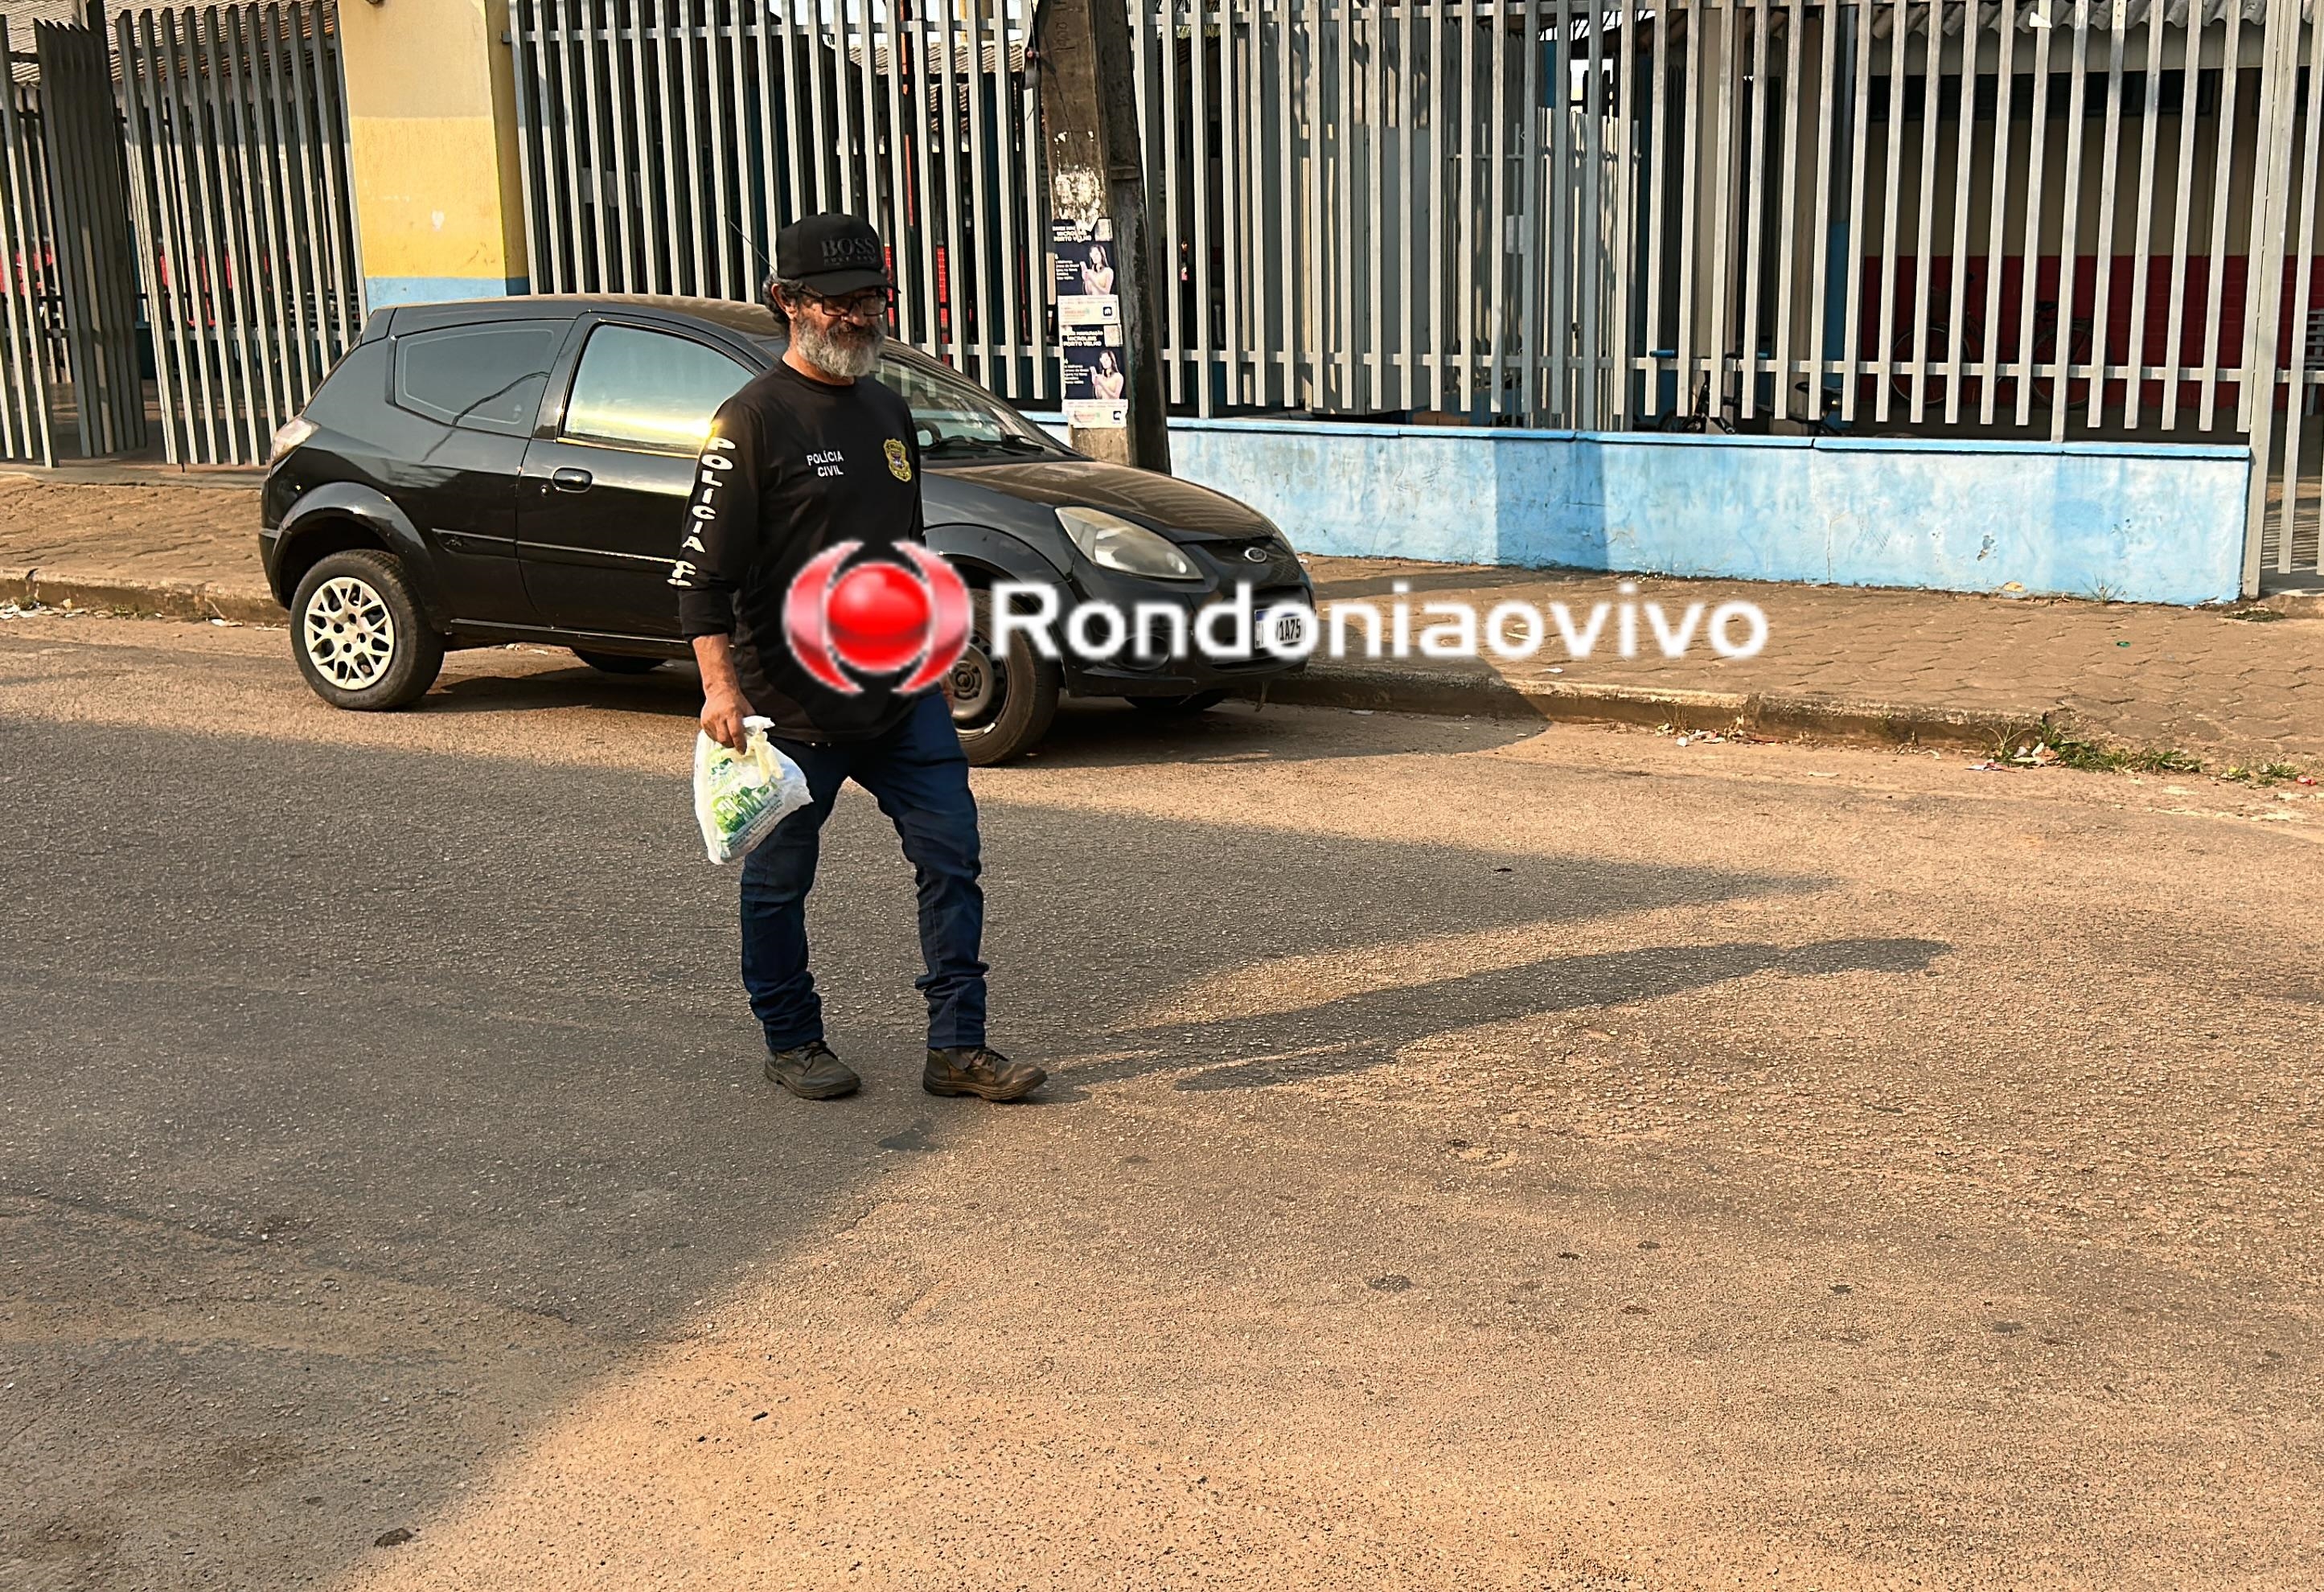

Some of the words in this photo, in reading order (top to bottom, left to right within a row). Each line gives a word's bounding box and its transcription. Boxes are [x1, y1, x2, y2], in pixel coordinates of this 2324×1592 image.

[821, 238, 876, 257] BOSS
[807, 449, 844, 466] POLÍCIA
[817, 465, 844, 478] CIVIL
